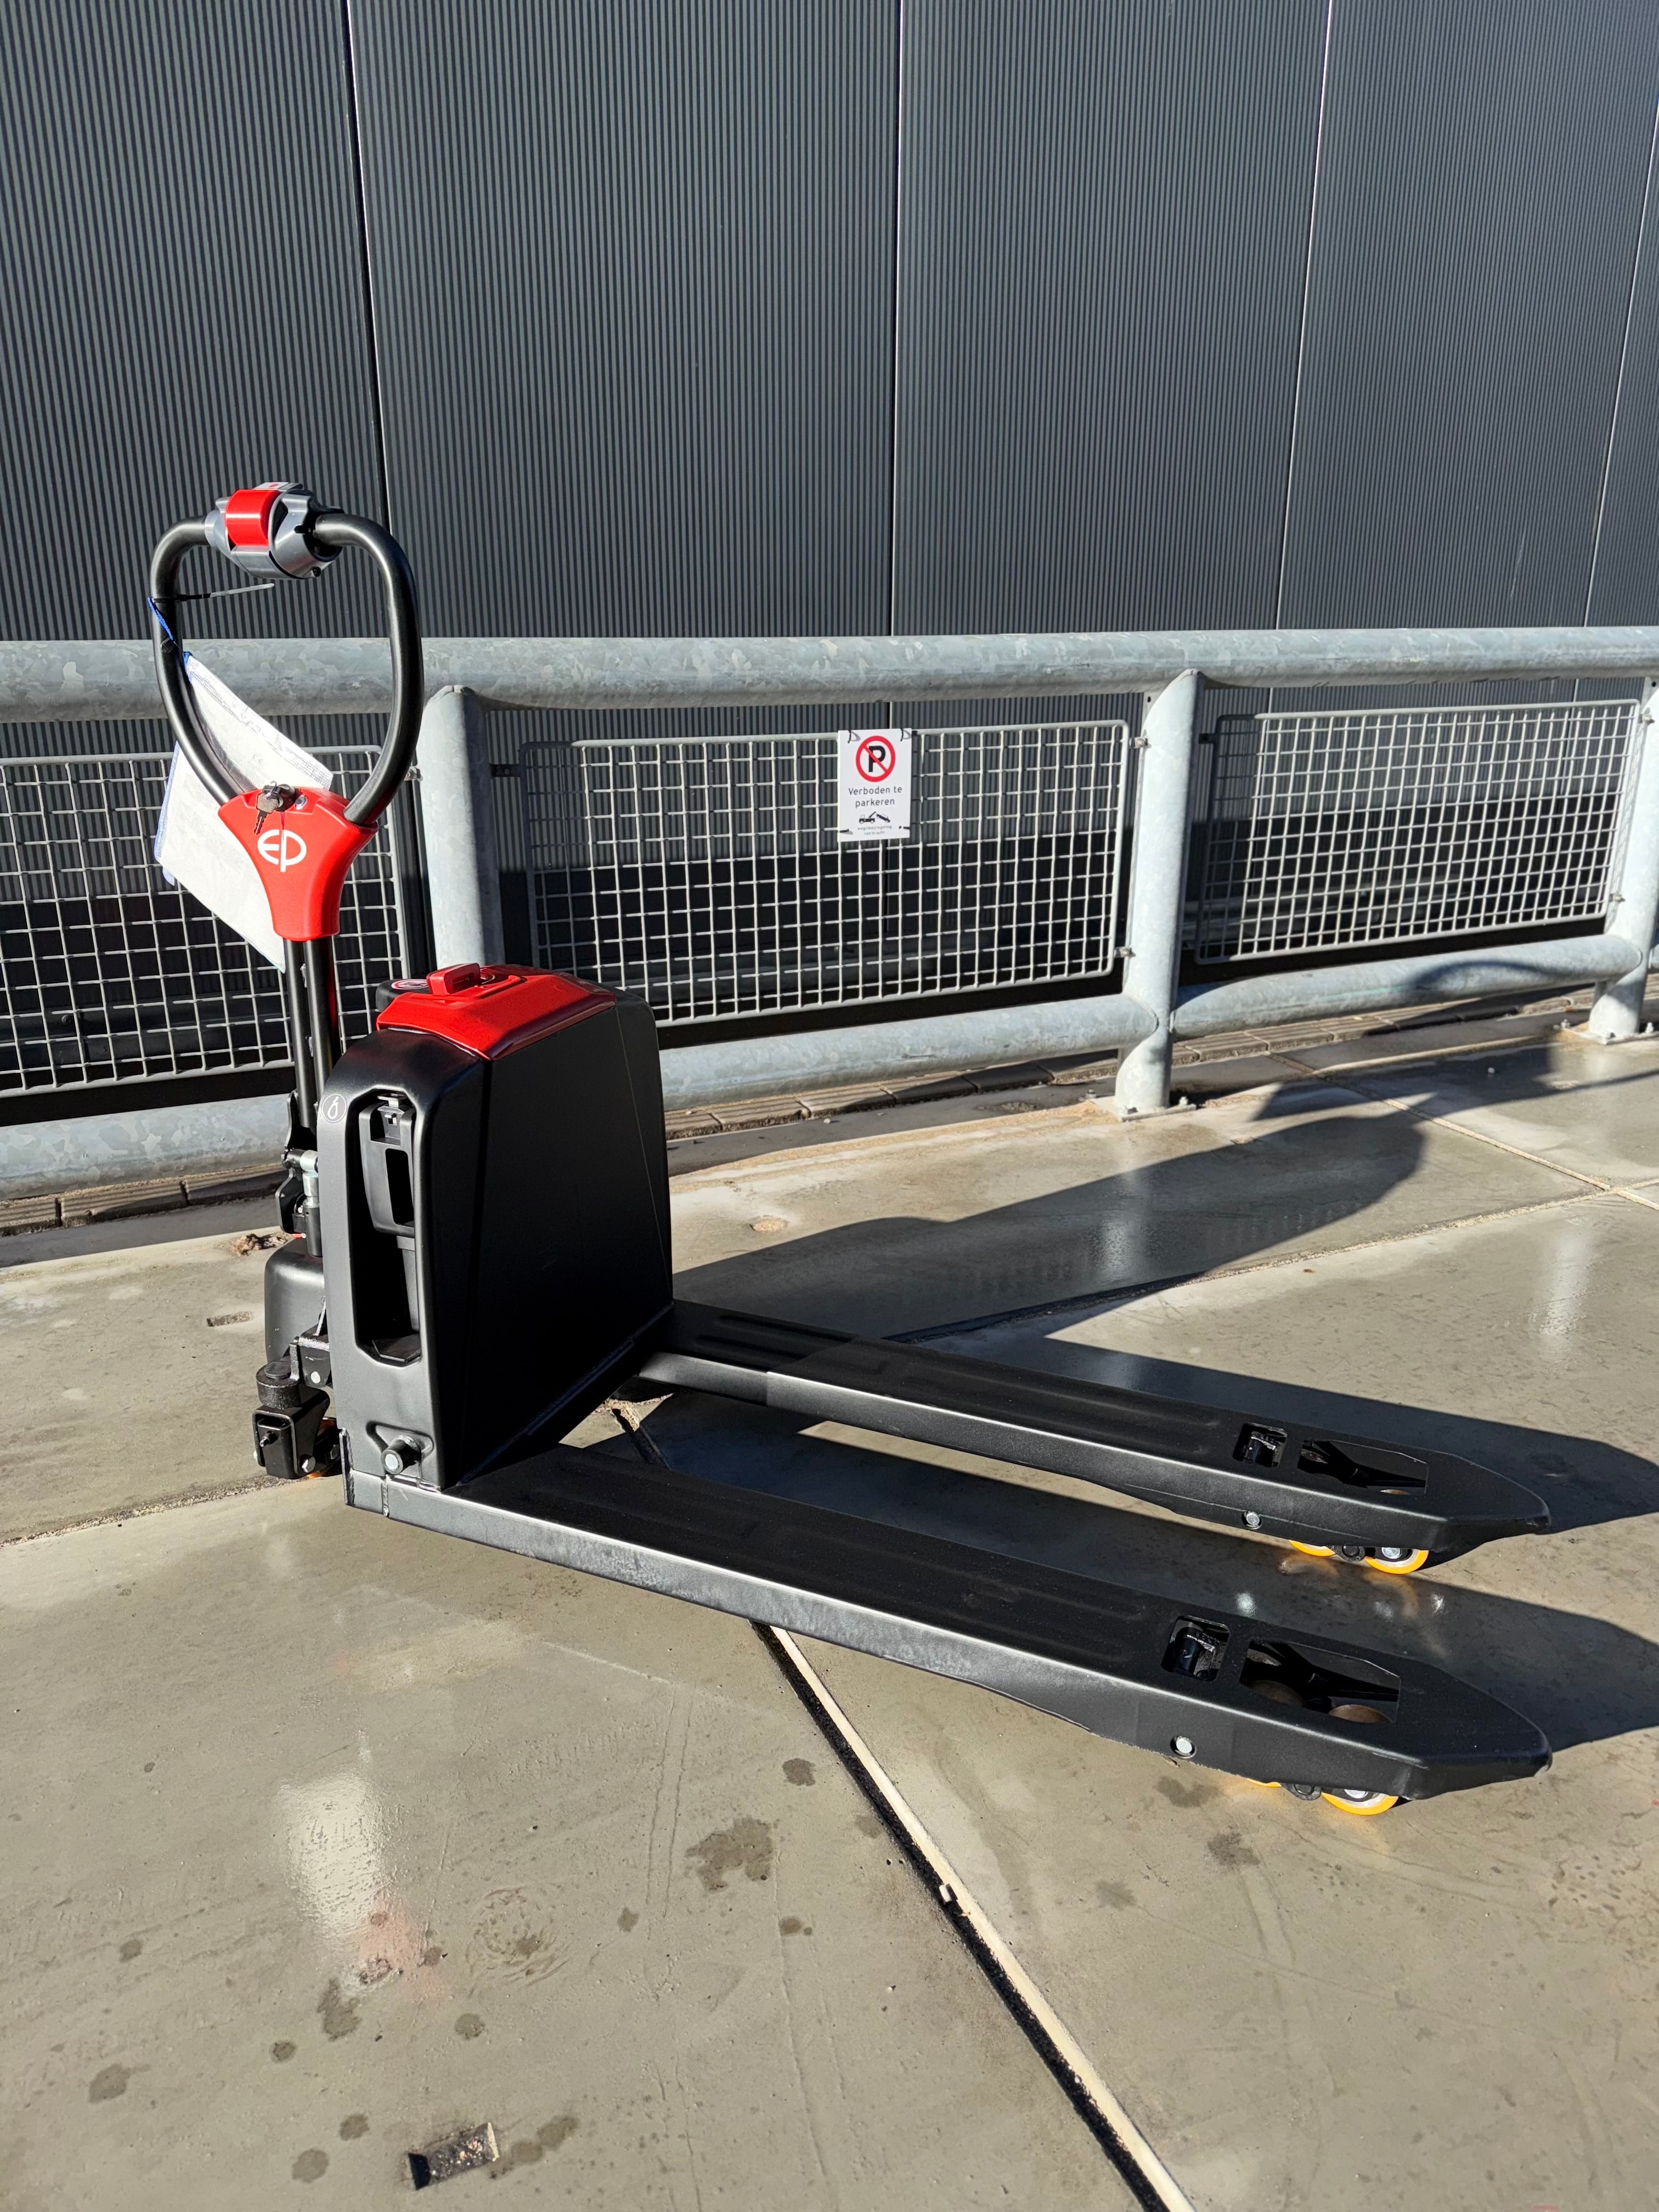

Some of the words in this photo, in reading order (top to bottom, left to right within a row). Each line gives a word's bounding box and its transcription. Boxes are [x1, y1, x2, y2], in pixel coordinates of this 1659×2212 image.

[868, 746, 886, 772] P
[848, 786, 890, 795] Verboden
[855, 798, 895, 809] parkeren
[257, 829, 307, 873] EP
